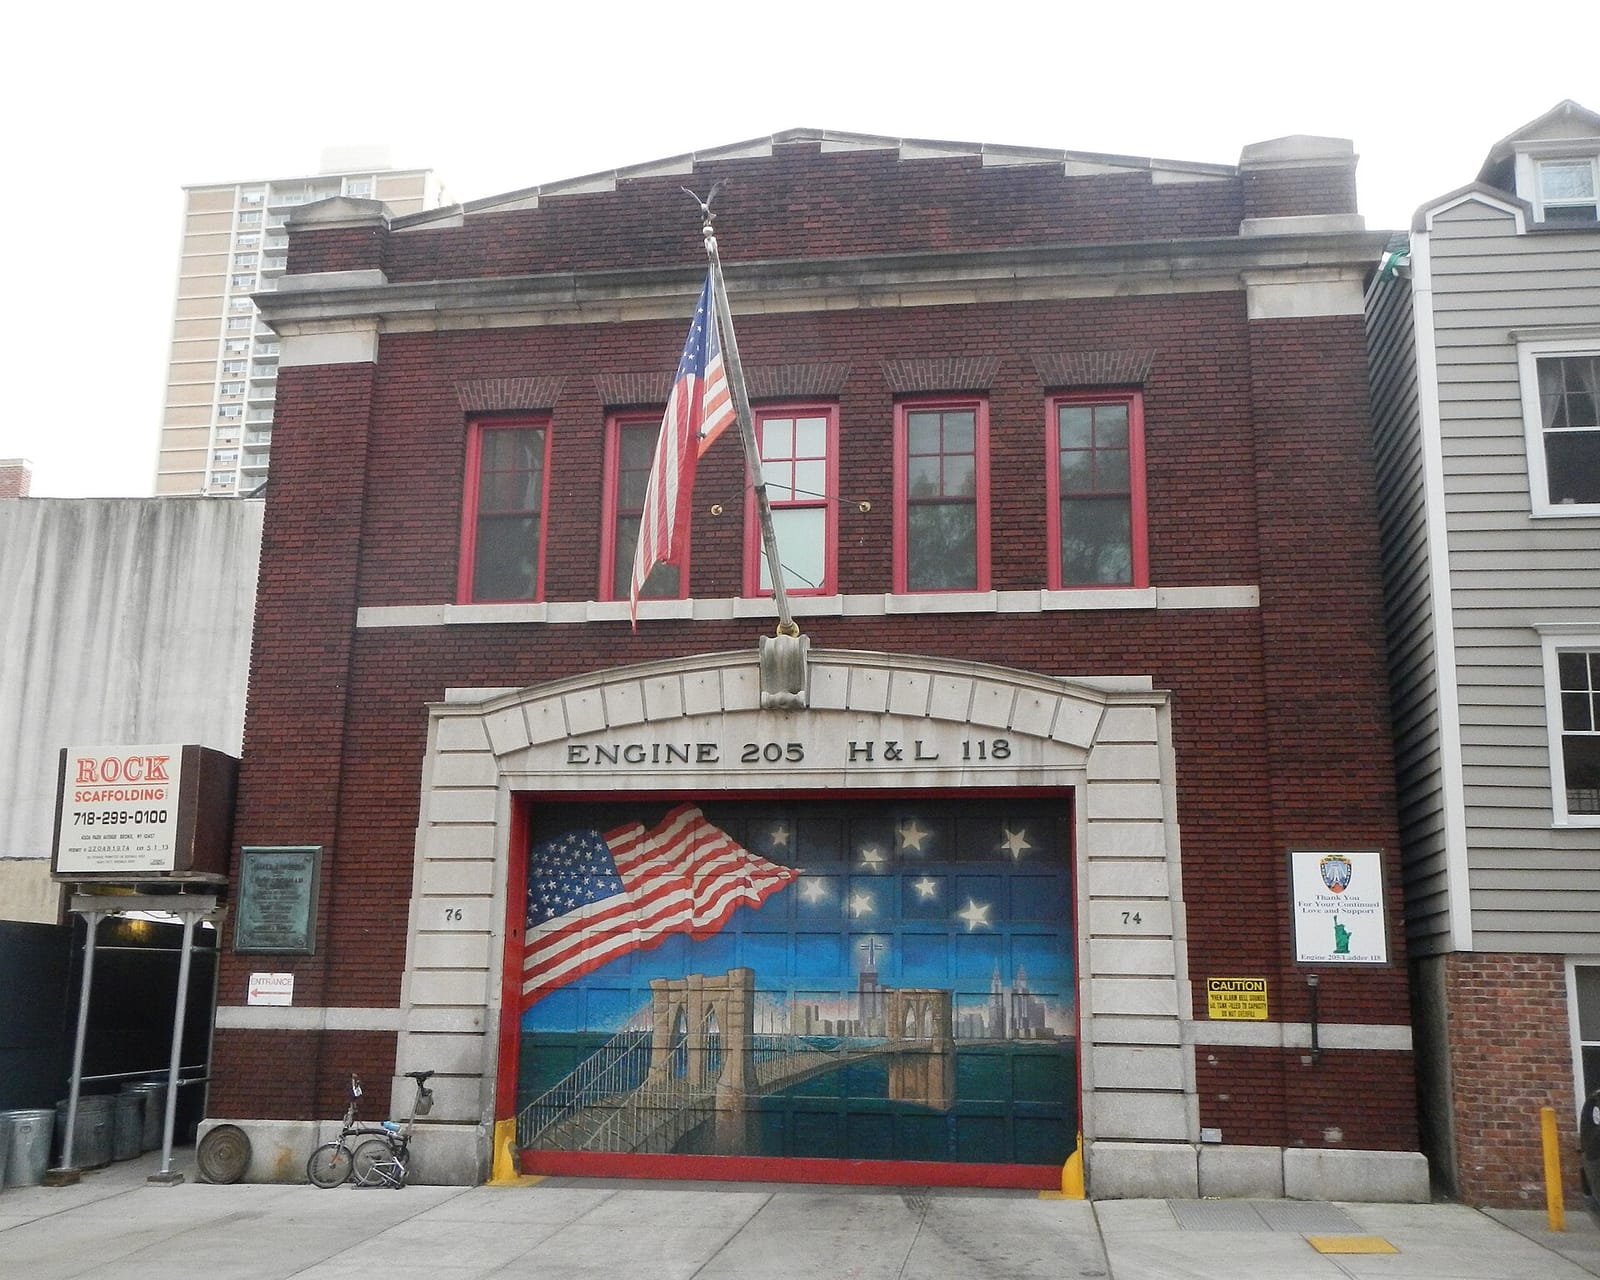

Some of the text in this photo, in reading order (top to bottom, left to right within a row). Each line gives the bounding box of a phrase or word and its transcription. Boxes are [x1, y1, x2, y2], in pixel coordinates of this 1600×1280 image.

[566, 743, 720, 764] ENGINE
[741, 742, 805, 763] 205
[962, 739, 1012, 760] 118
[75, 755, 170, 783] ROCK
[74, 789, 165, 803] SCAFFOLDING
[73, 810, 168, 826] 718-299-0100
[445, 908, 463, 921] 76
[1121, 911, 1142, 925] 74
[1341, 907, 1375, 915] Support
[250, 977, 293, 986] ENTRANCE
[1211, 981, 1263, 991] CAUTION
